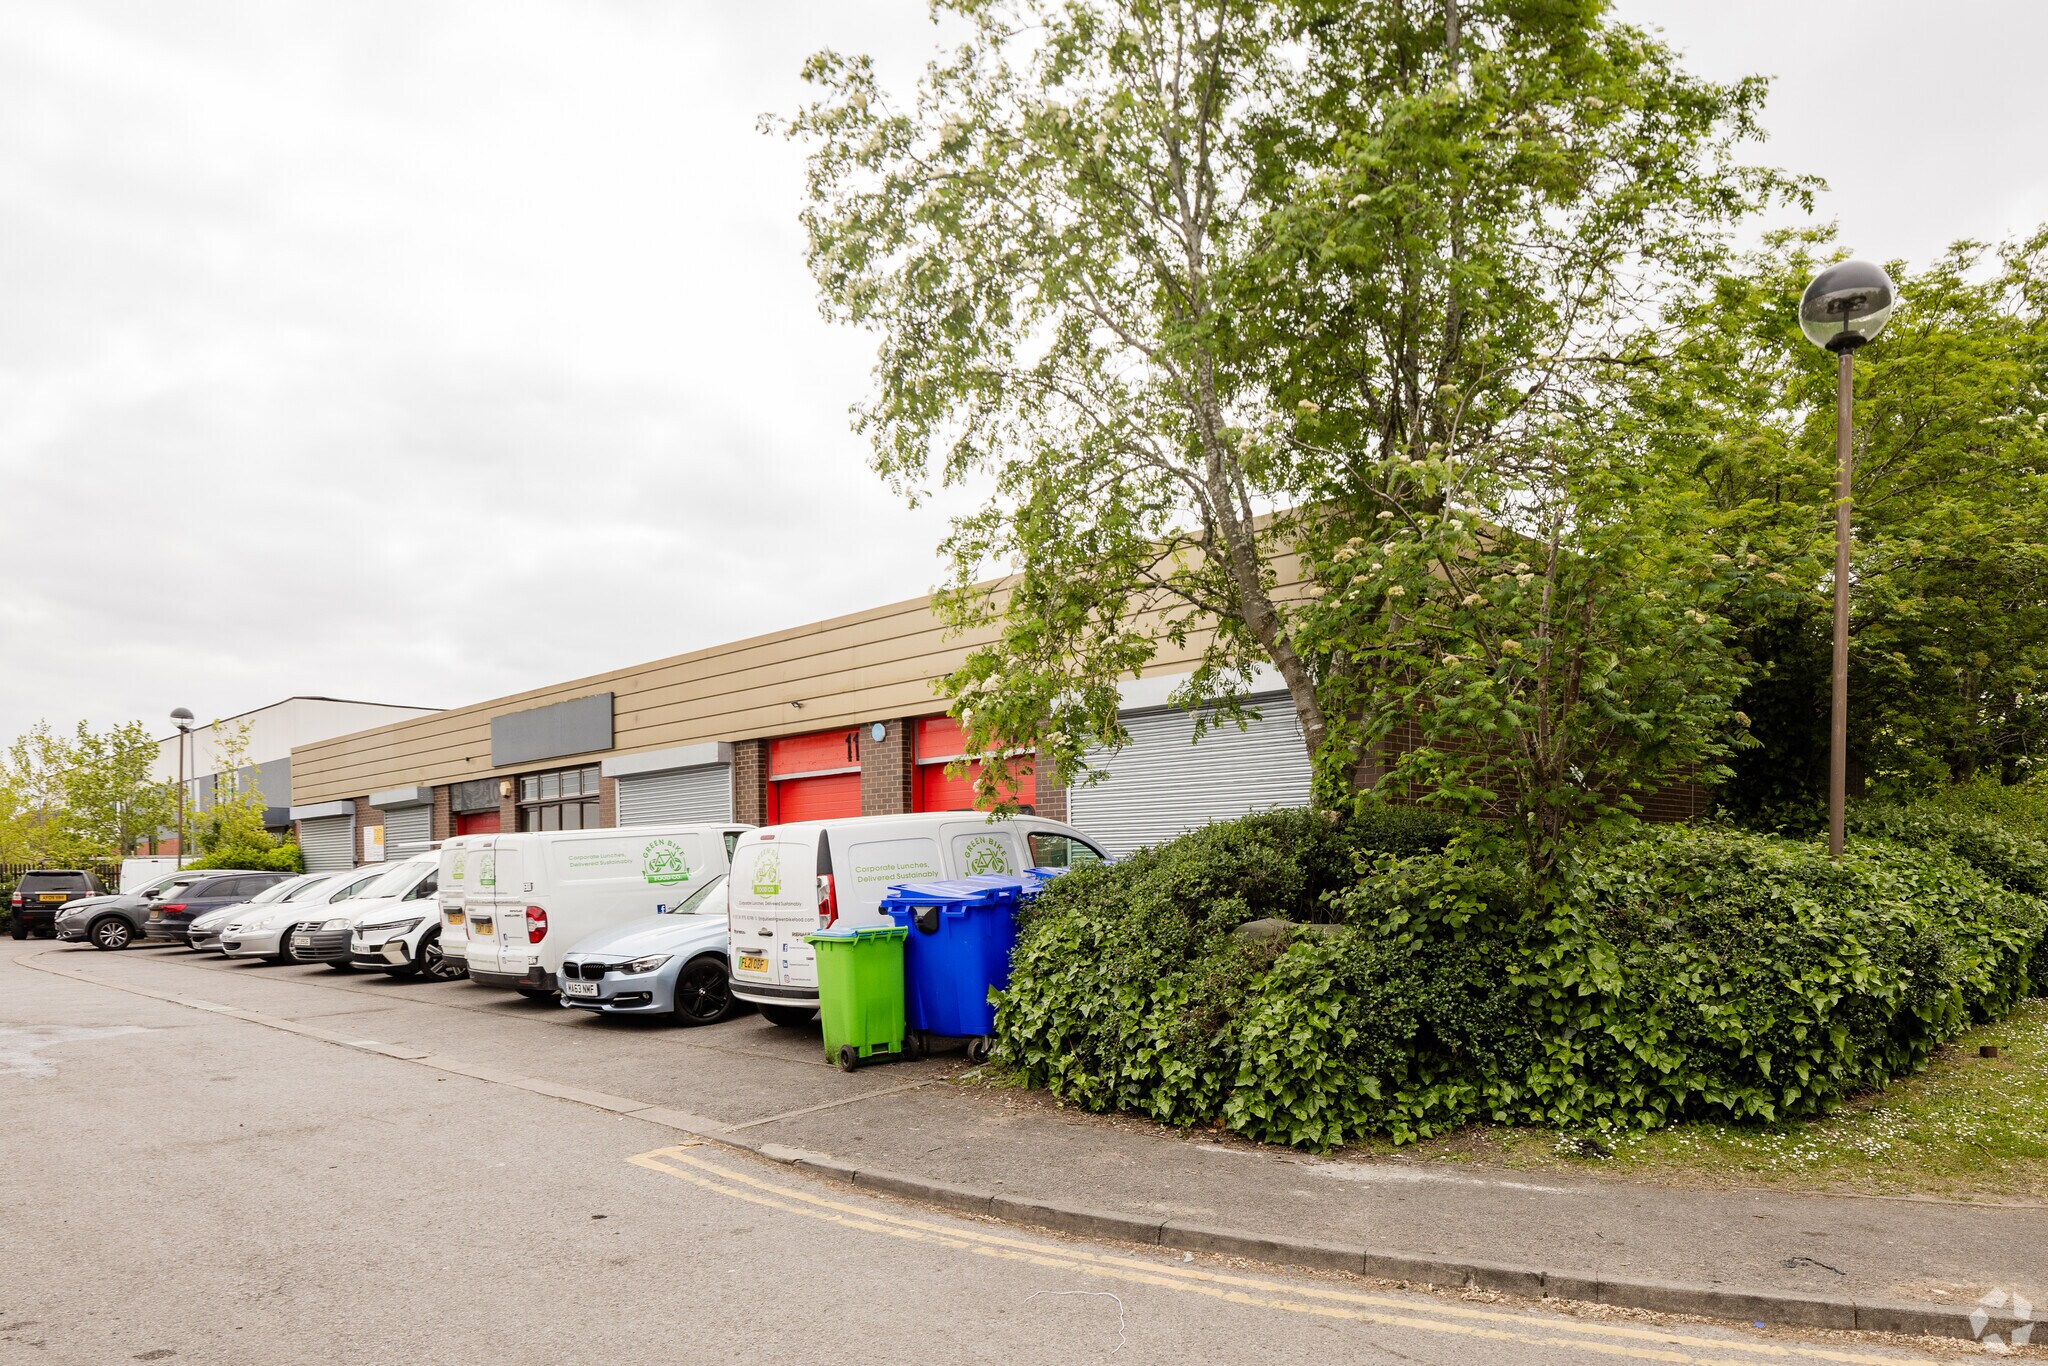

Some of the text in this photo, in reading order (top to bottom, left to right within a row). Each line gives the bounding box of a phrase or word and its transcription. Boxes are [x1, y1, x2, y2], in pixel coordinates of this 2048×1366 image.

[845, 731, 860, 762] 11
[642, 839, 685, 858] GREEN BIKE
[964, 836, 1007, 858] GREEN BIKE
[599, 858, 633, 866] Sustainably
[855, 861, 930, 874] Corporate Lunches,
[857, 870, 939, 883] Delivered Sustainably
[568, 983, 594, 994] MA63 NMF
